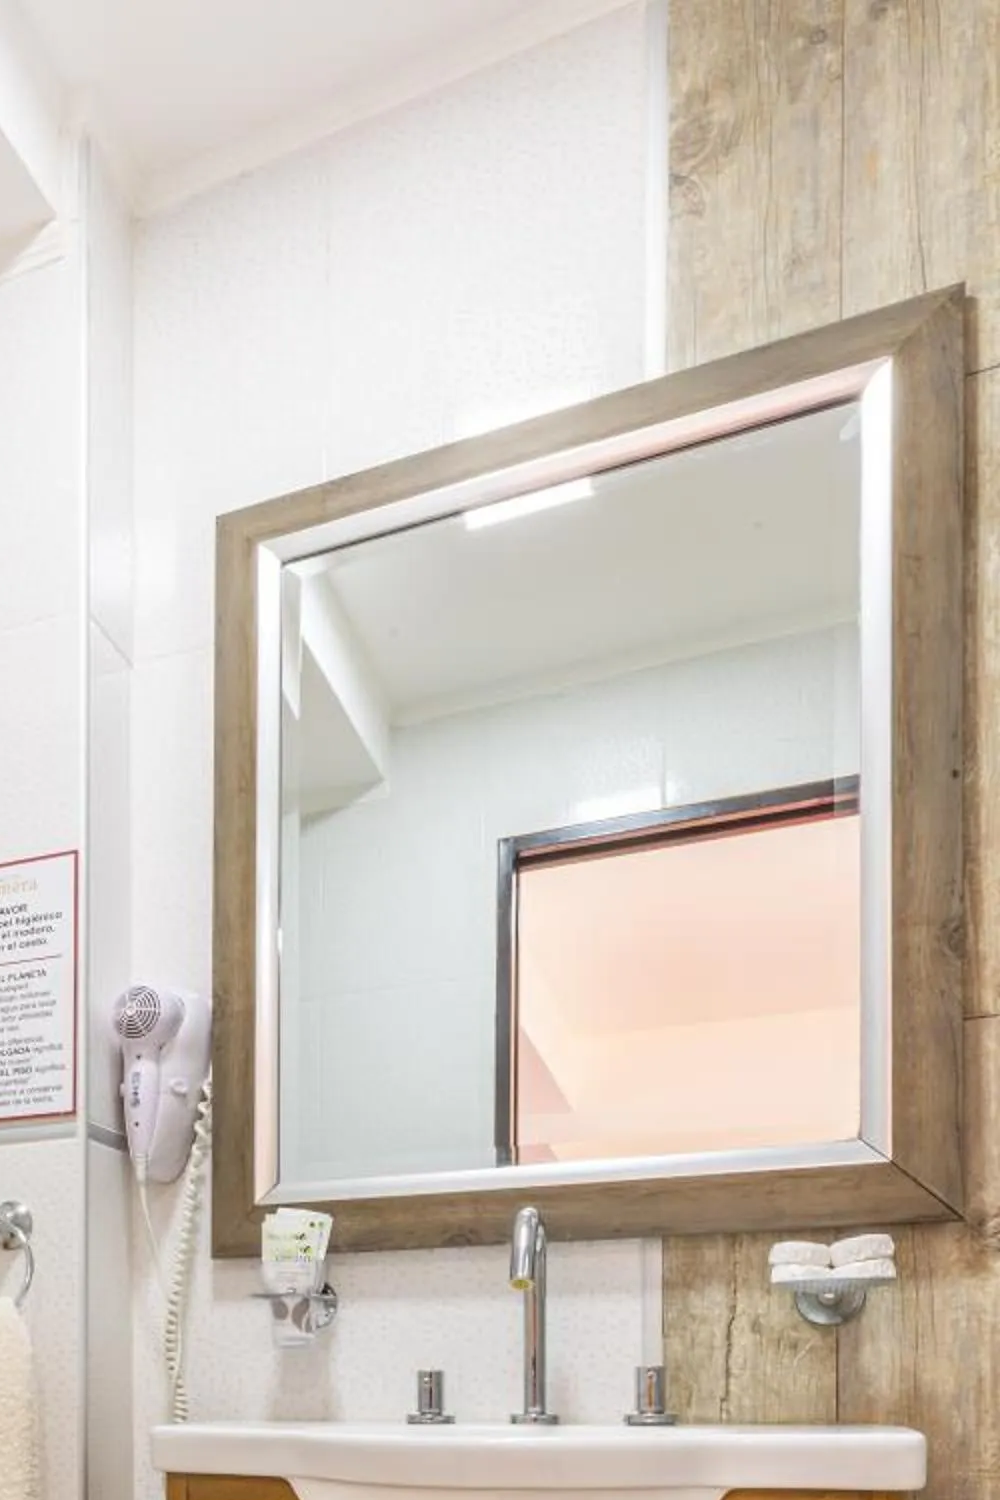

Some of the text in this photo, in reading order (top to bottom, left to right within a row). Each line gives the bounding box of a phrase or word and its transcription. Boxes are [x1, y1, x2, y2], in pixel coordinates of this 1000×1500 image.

[1, 930, 10, 939] el
[7, 941, 16, 950] el
[7, 968, 46, 982] PLANETA
